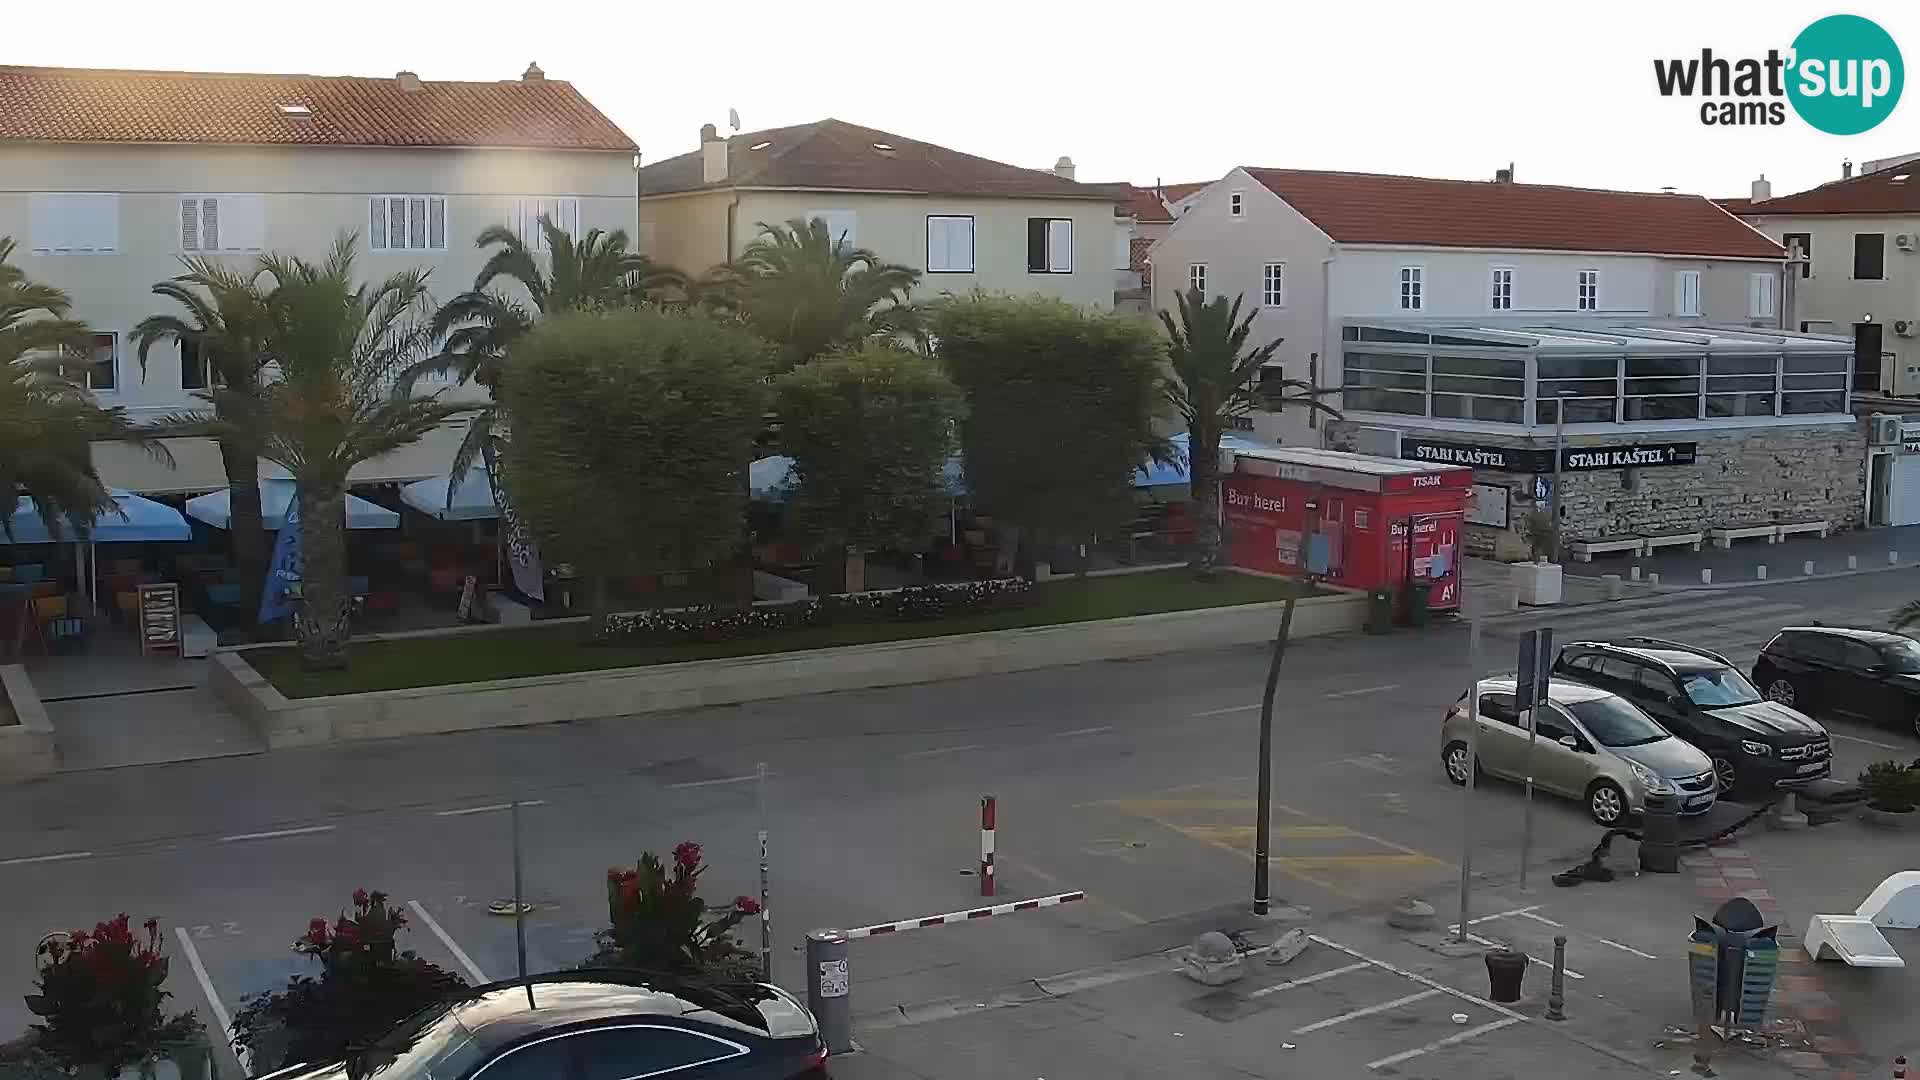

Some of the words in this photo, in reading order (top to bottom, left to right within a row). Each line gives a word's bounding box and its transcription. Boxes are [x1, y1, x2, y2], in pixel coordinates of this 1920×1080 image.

[1416, 445, 1453, 461] STARI
[1456, 447, 1506, 467] KAŠTEL
[1568, 452, 1609, 468] STARI
[1612, 447, 1664, 466] KAŠTEL
[1412, 475, 1442, 487] TISAK
